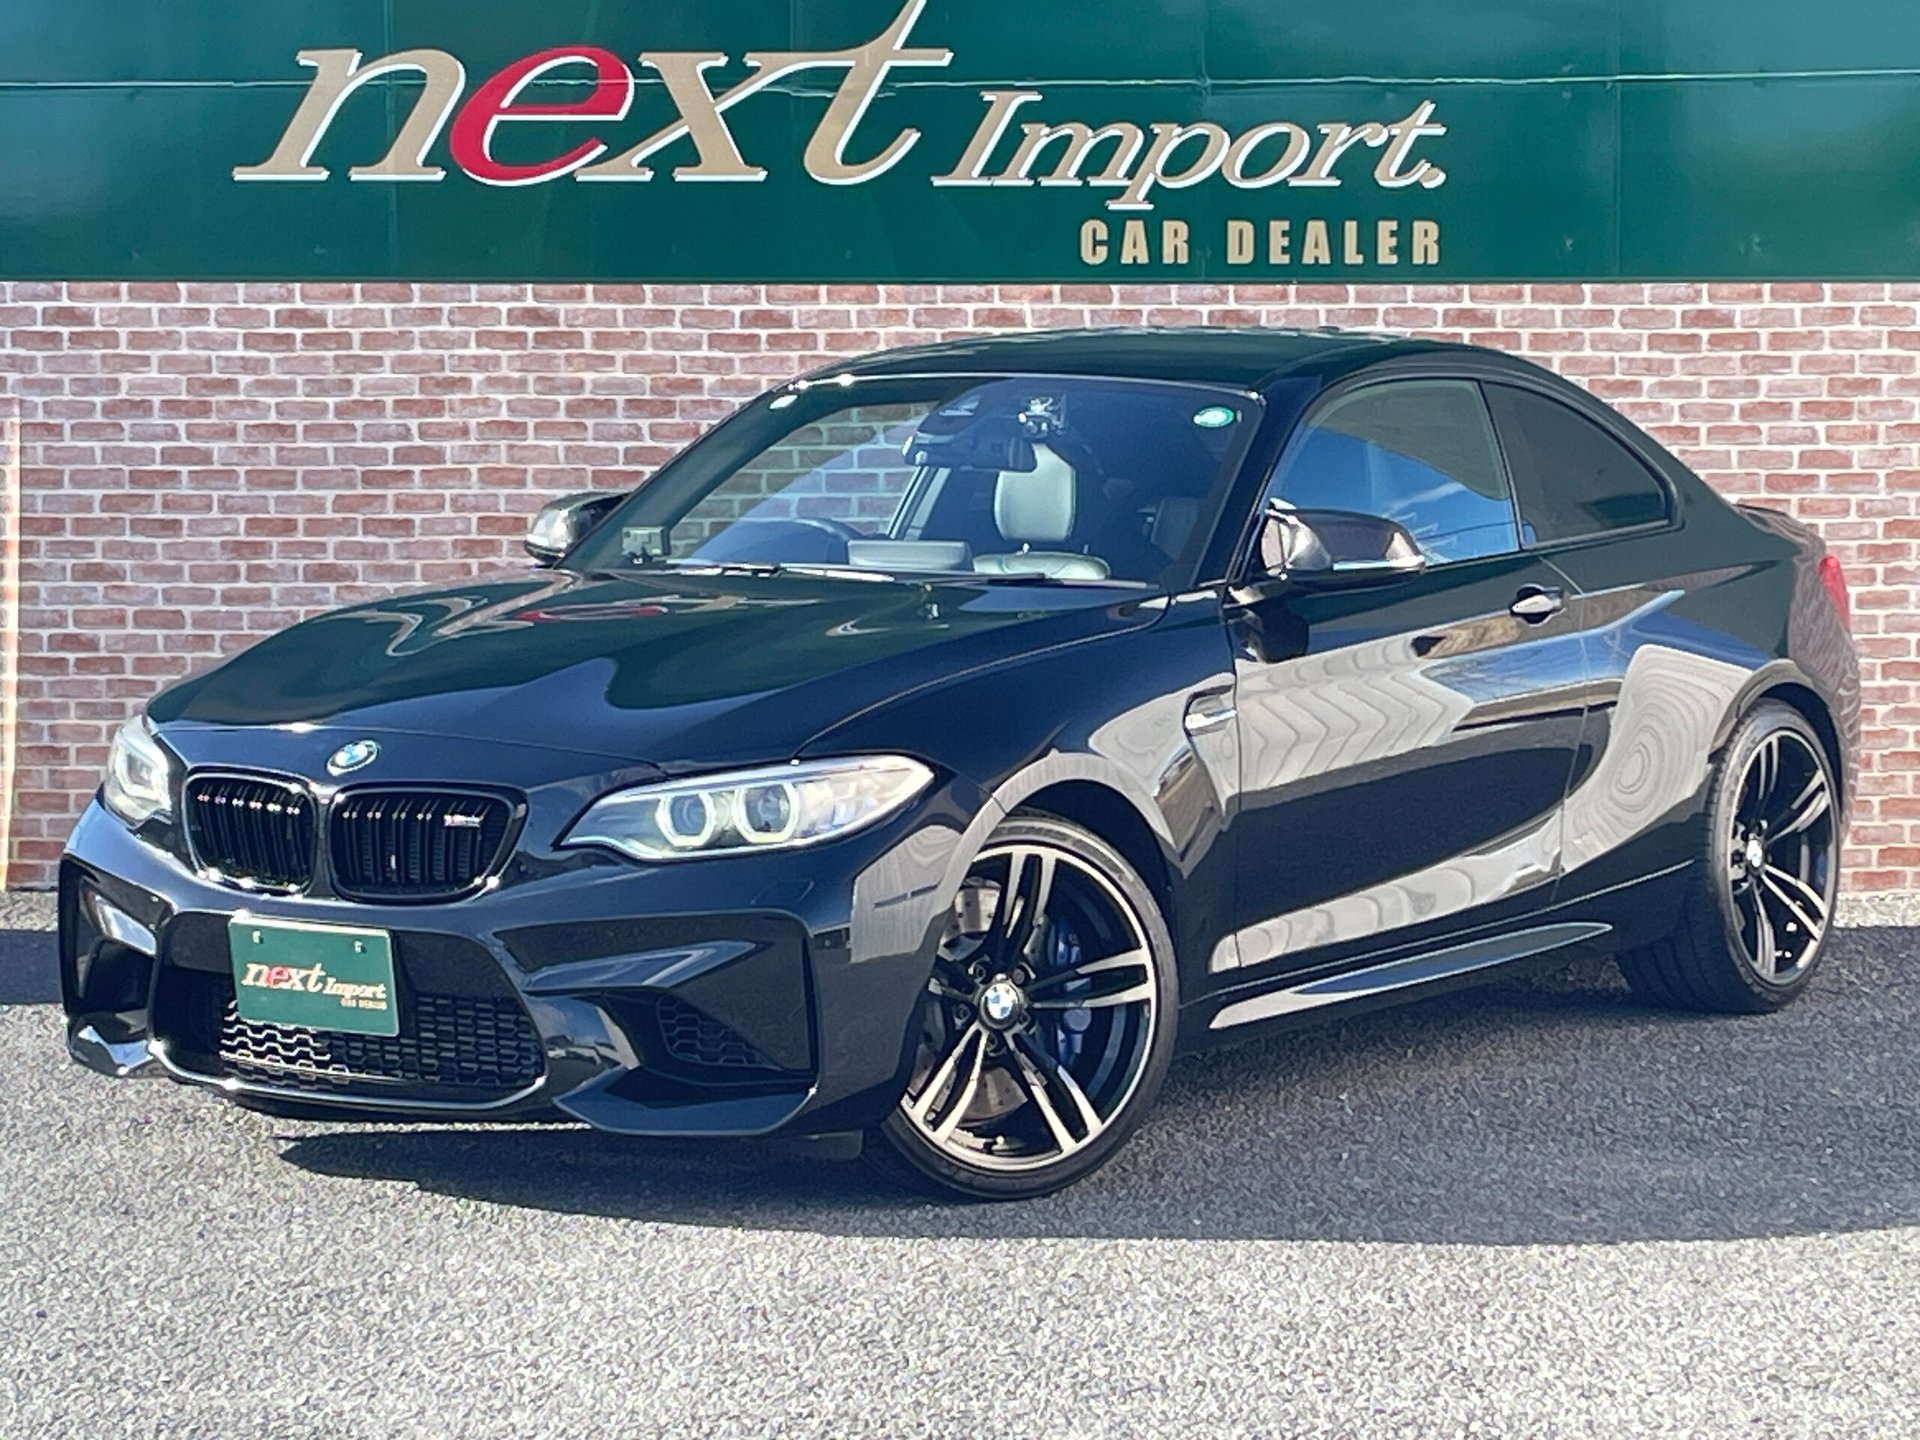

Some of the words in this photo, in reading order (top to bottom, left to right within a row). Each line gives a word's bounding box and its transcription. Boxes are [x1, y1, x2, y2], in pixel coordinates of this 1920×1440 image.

[232, 0, 954, 186] next
[1080, 219, 1190, 265] CAR
[1226, 219, 1441, 265] DEALER
[241, 962, 326, 992] next
